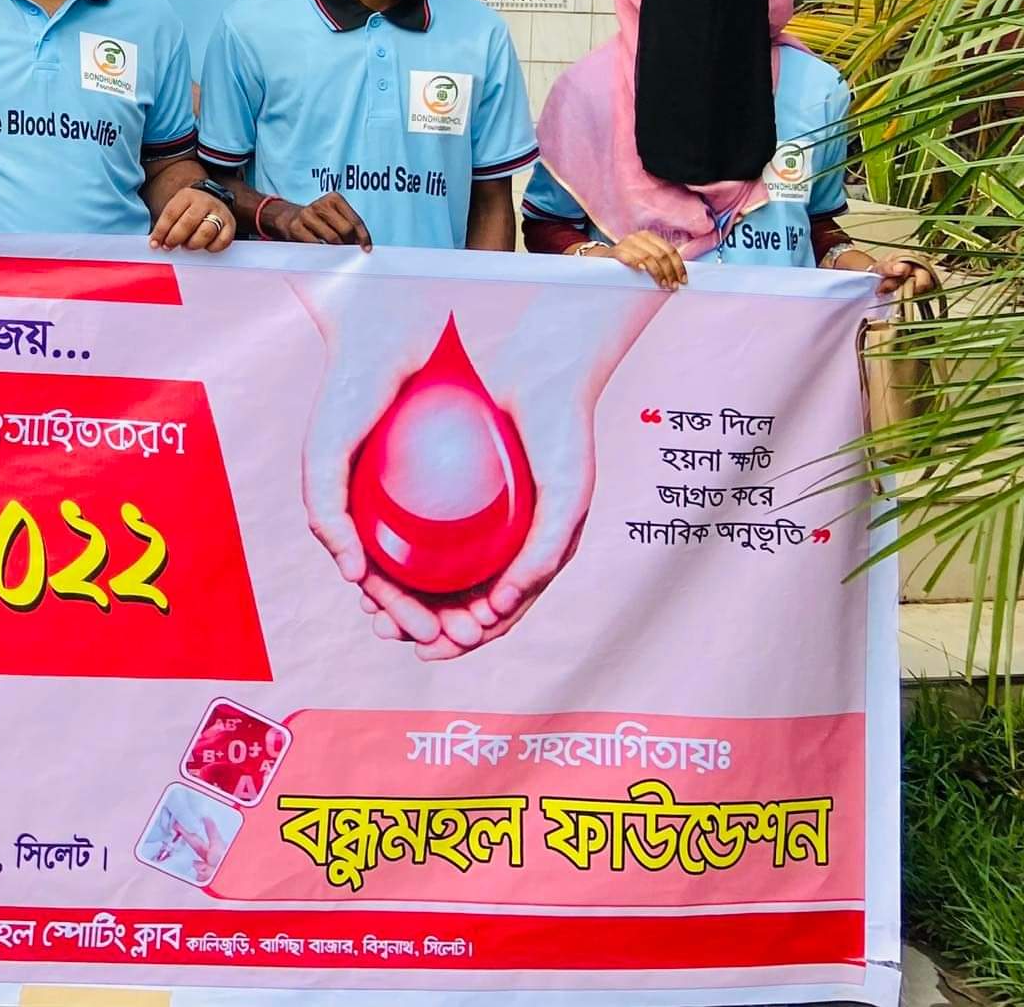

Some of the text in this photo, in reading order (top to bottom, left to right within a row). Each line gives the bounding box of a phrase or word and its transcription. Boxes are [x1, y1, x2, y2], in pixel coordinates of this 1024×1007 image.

[7, 110, 56, 137] Blood
[346, 165, 390, 191] Blood
[742, 224, 781, 250] Save
[720, 408, 775, 436] দিলে
[659, 446, 775, 472] হয়না ক্ষতি
[656, 484, 775, 508] জাগ্রত করে
[625, 519, 711, 545] মানবিক
[406, 719, 732, 774] সার্বিক সহযোগিতায়ঃ
[277, 795, 528, 892] বন্ধুমহল
[43, 912, 126, 953] স্পোর্টিং
[130, 922, 182, 958] ক্লাব
[308, 937, 358, 957] বাজার,
[363, 934, 420, 959] বিশ্বনাথ,
